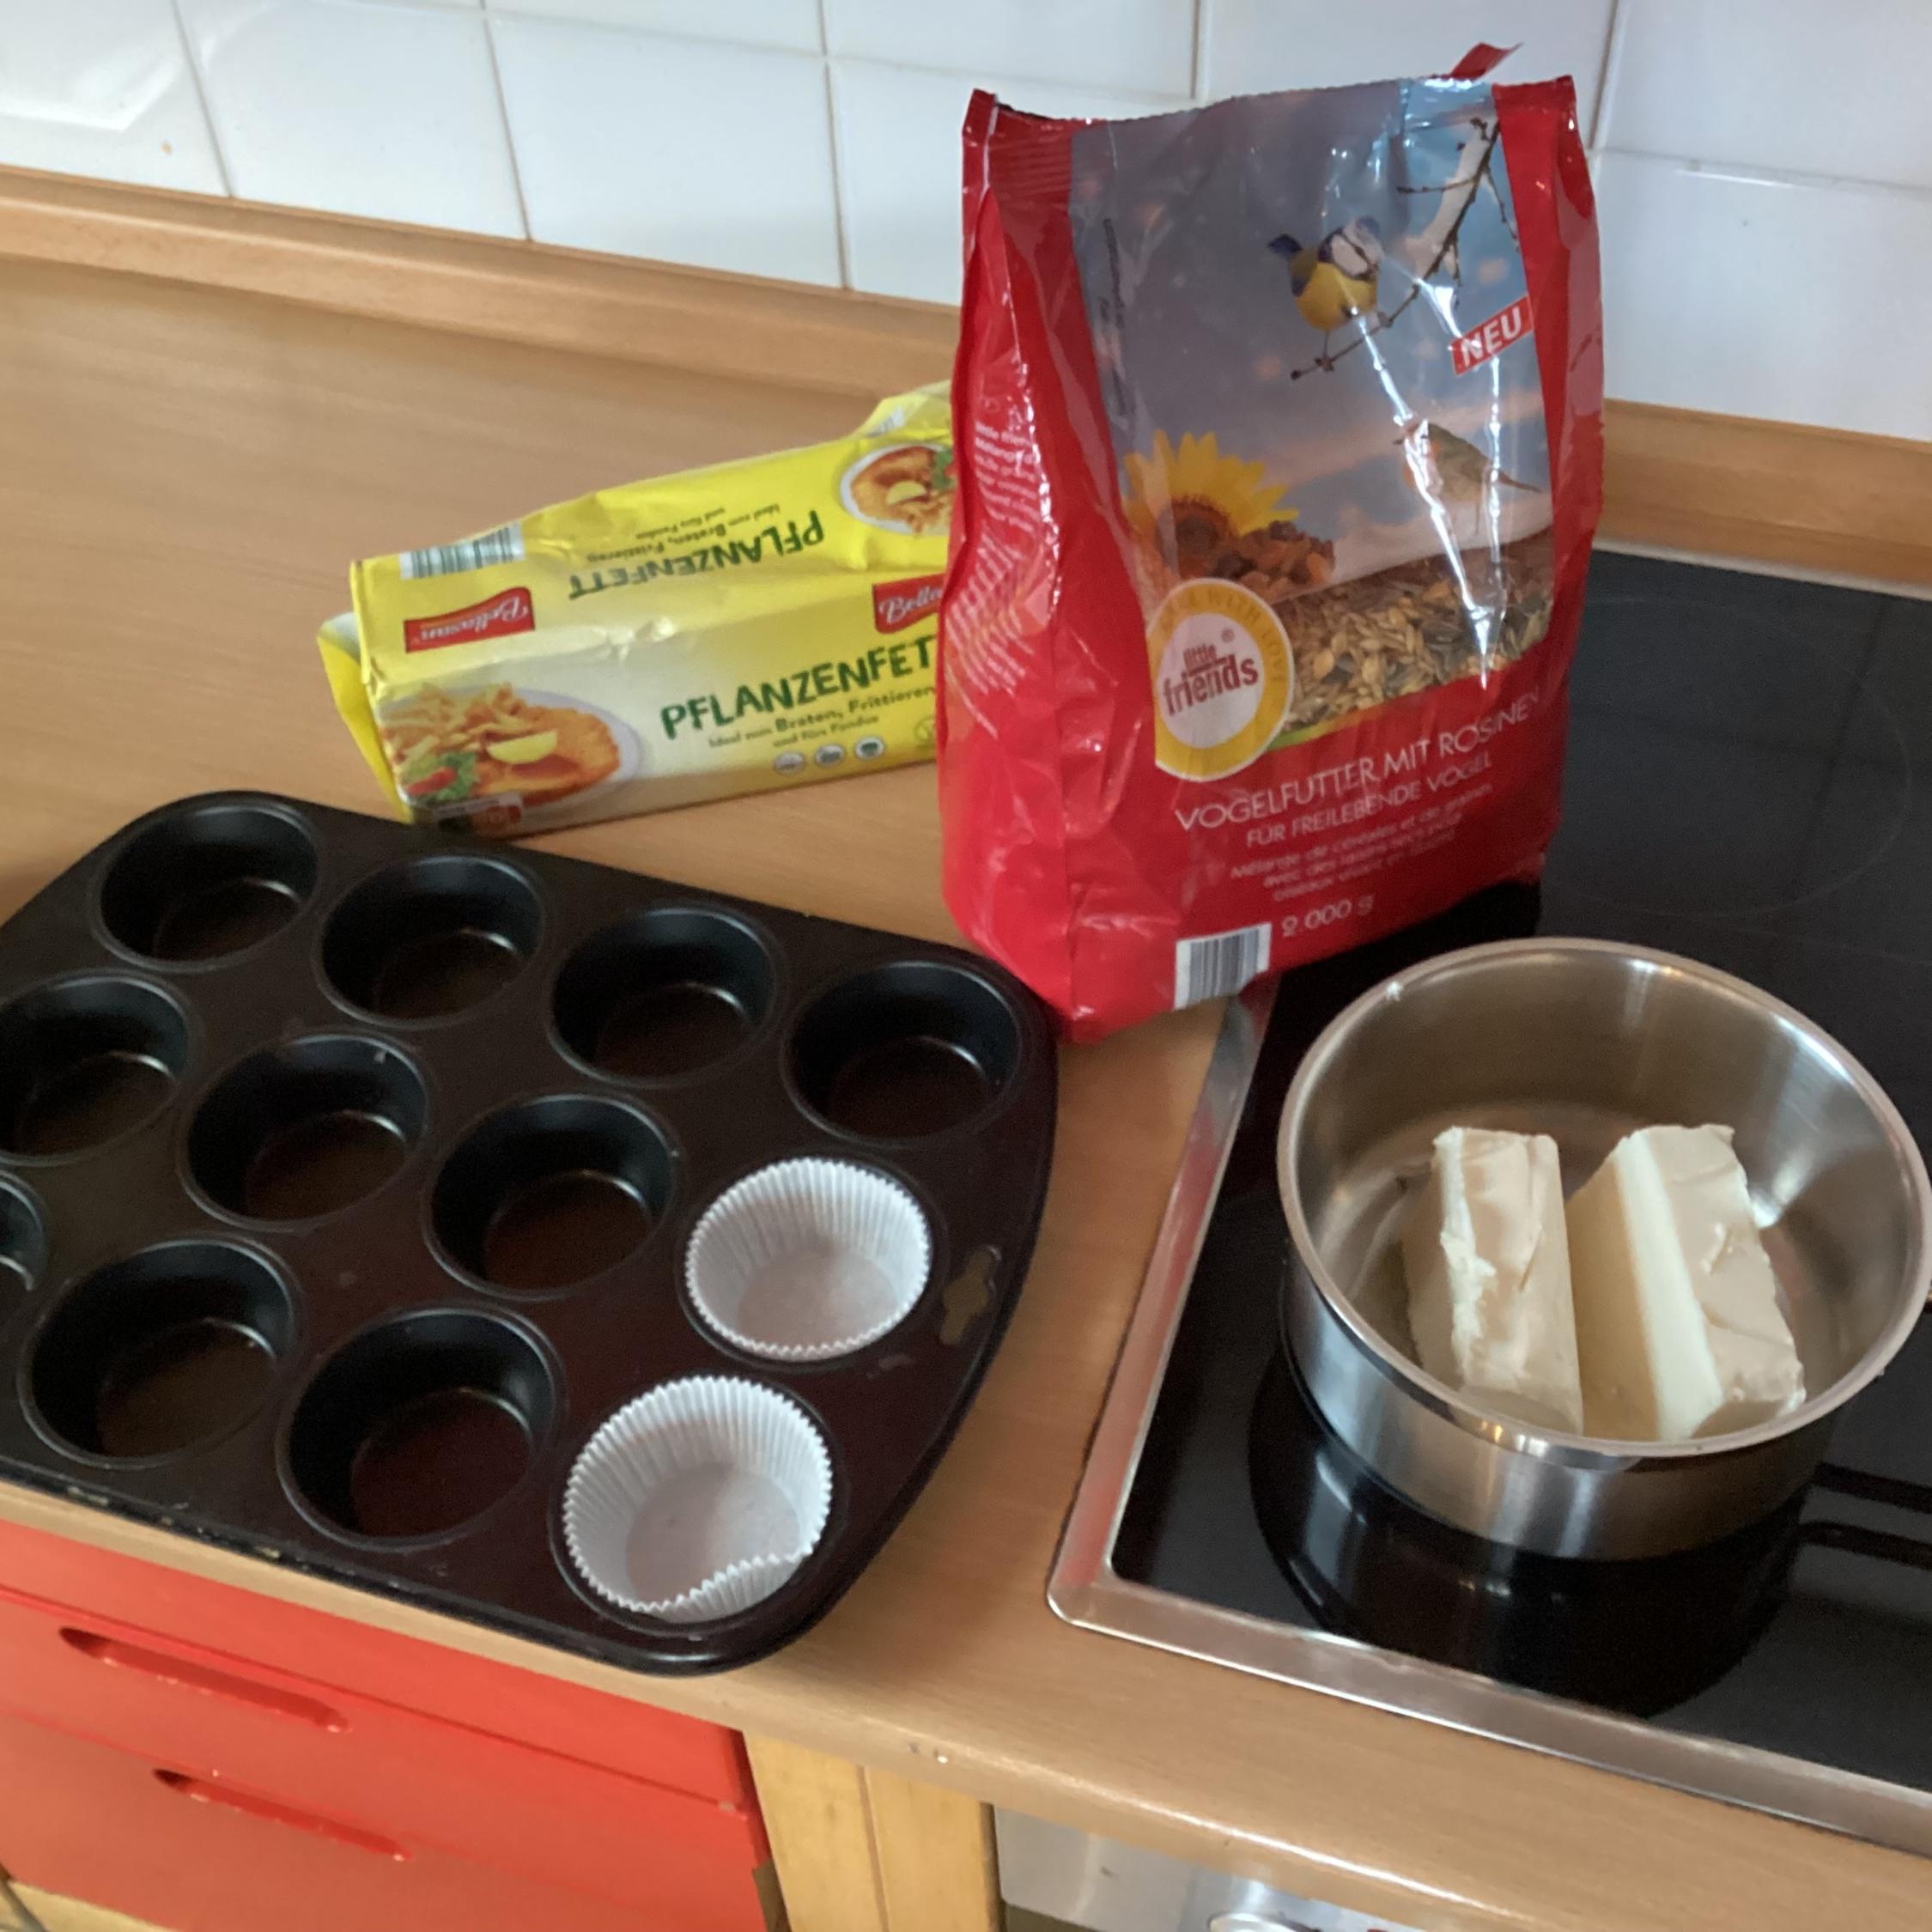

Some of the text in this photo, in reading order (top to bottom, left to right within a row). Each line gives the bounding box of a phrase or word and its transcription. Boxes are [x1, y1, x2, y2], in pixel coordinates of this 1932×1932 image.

[1461, 306, 1522, 367] NEU
[568, 510, 824, 600] PFLANZENFETT
[878, 586, 943, 625] Bella
[660, 634, 937, 740] PFLANZENFET
[1163, 654, 1259, 716] friends
[775, 709, 843, 732] Braten,
[1175, 756, 1376, 832] VOGELFUTTER
[1382, 738, 1431, 776] MIT
[1291, 780, 1422, 838] FREILEBENDE
